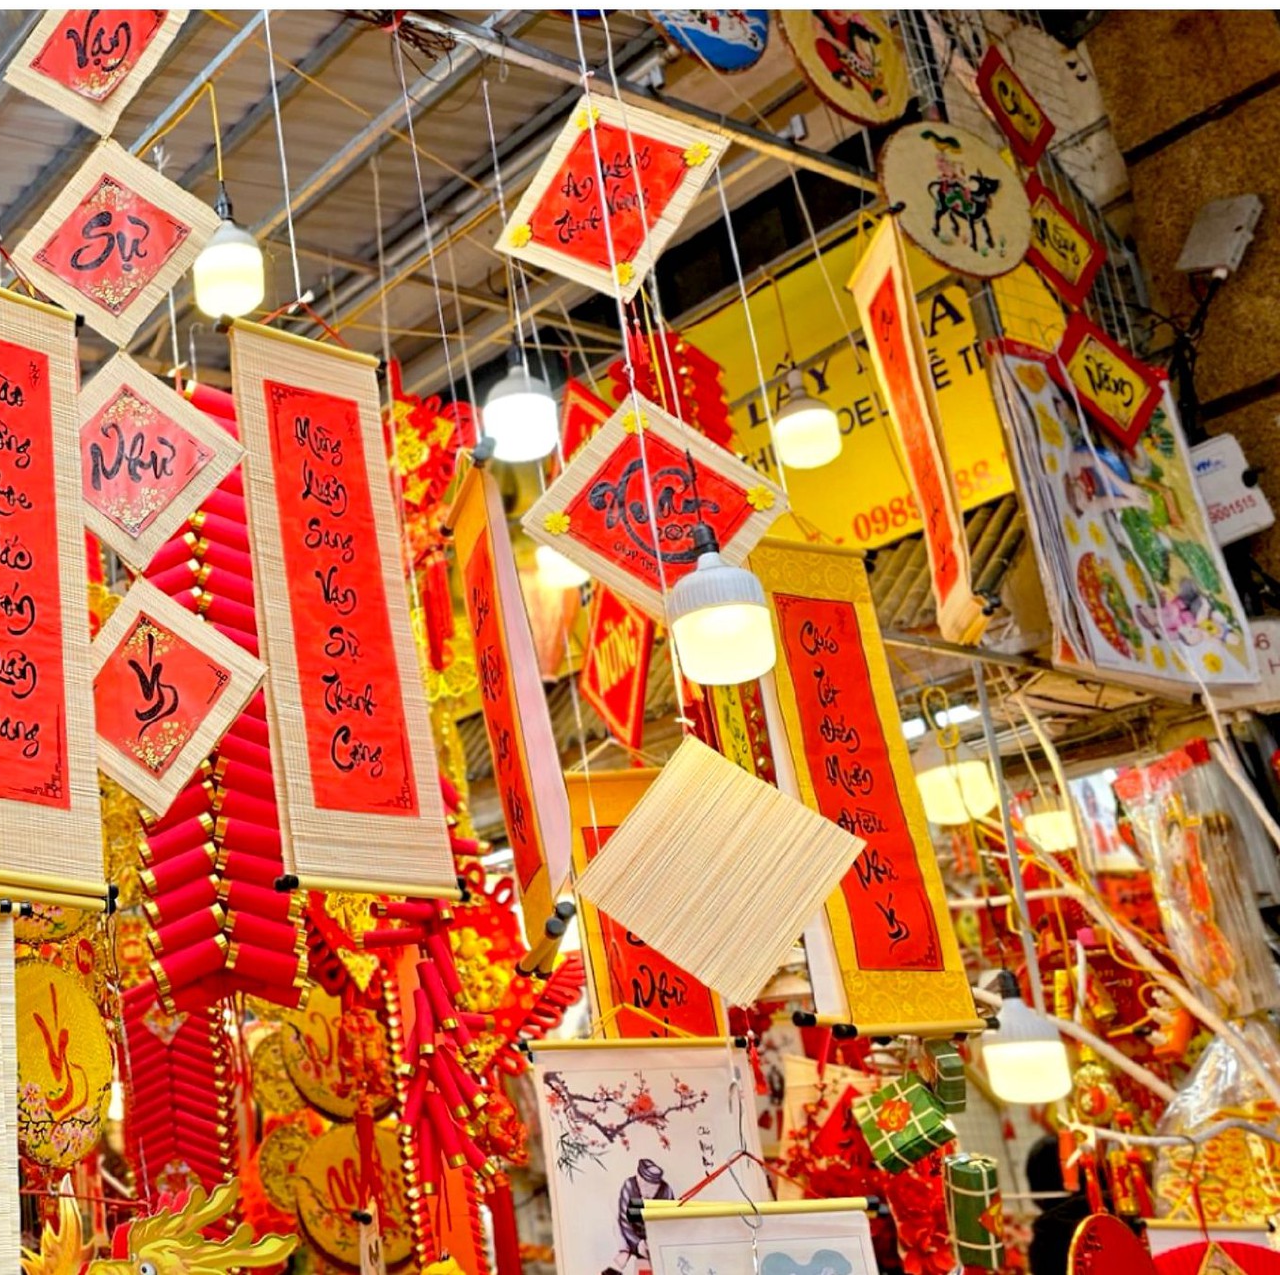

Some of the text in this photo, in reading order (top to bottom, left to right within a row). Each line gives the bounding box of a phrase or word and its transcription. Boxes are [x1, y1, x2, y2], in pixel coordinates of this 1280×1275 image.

[66, 9, 132, 72] Vạn
[71, 211, 151, 275] Sự
[90, 428, 175, 493] Như
[294, 417, 344, 467] Mừng
[302, 459, 348, 517] Xuân
[305, 517, 355, 564] Sang
[314, 566, 357, 616] Vạn
[324, 625, 365, 664] Sự
[128, 633, 179, 742] Ý
[321, 667, 378, 717] Thành
